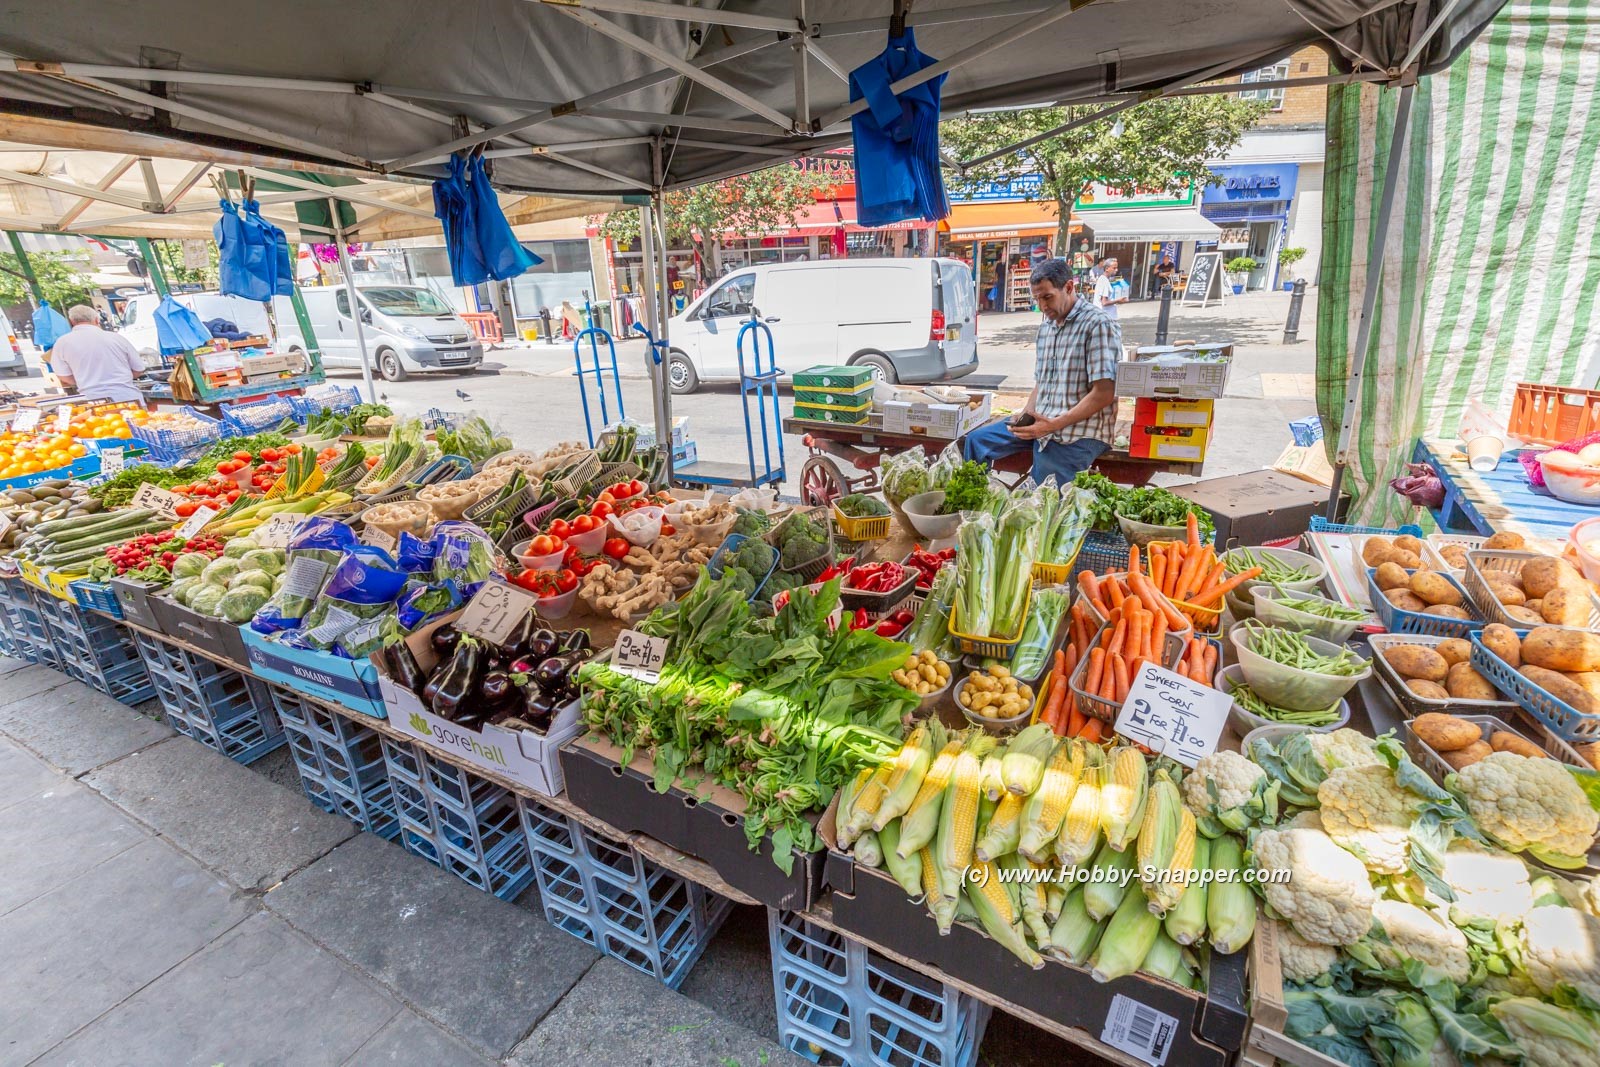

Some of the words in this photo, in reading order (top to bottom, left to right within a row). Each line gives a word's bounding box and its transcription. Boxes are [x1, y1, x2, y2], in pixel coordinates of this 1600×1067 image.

[1226, 176, 1280, 189] DIMPLES
[478, 585, 504, 609] 2
[618, 635, 632, 661] 2
[292, 665, 335, 687] ROMAINE
[1145, 668, 1187, 691] SWEET
[1130, 698, 1152, 726] 2
[1158, 691, 1194, 711] CORN
[432, 723, 507, 767] gorehall
[1260, 919, 1274, 966] PRINC
